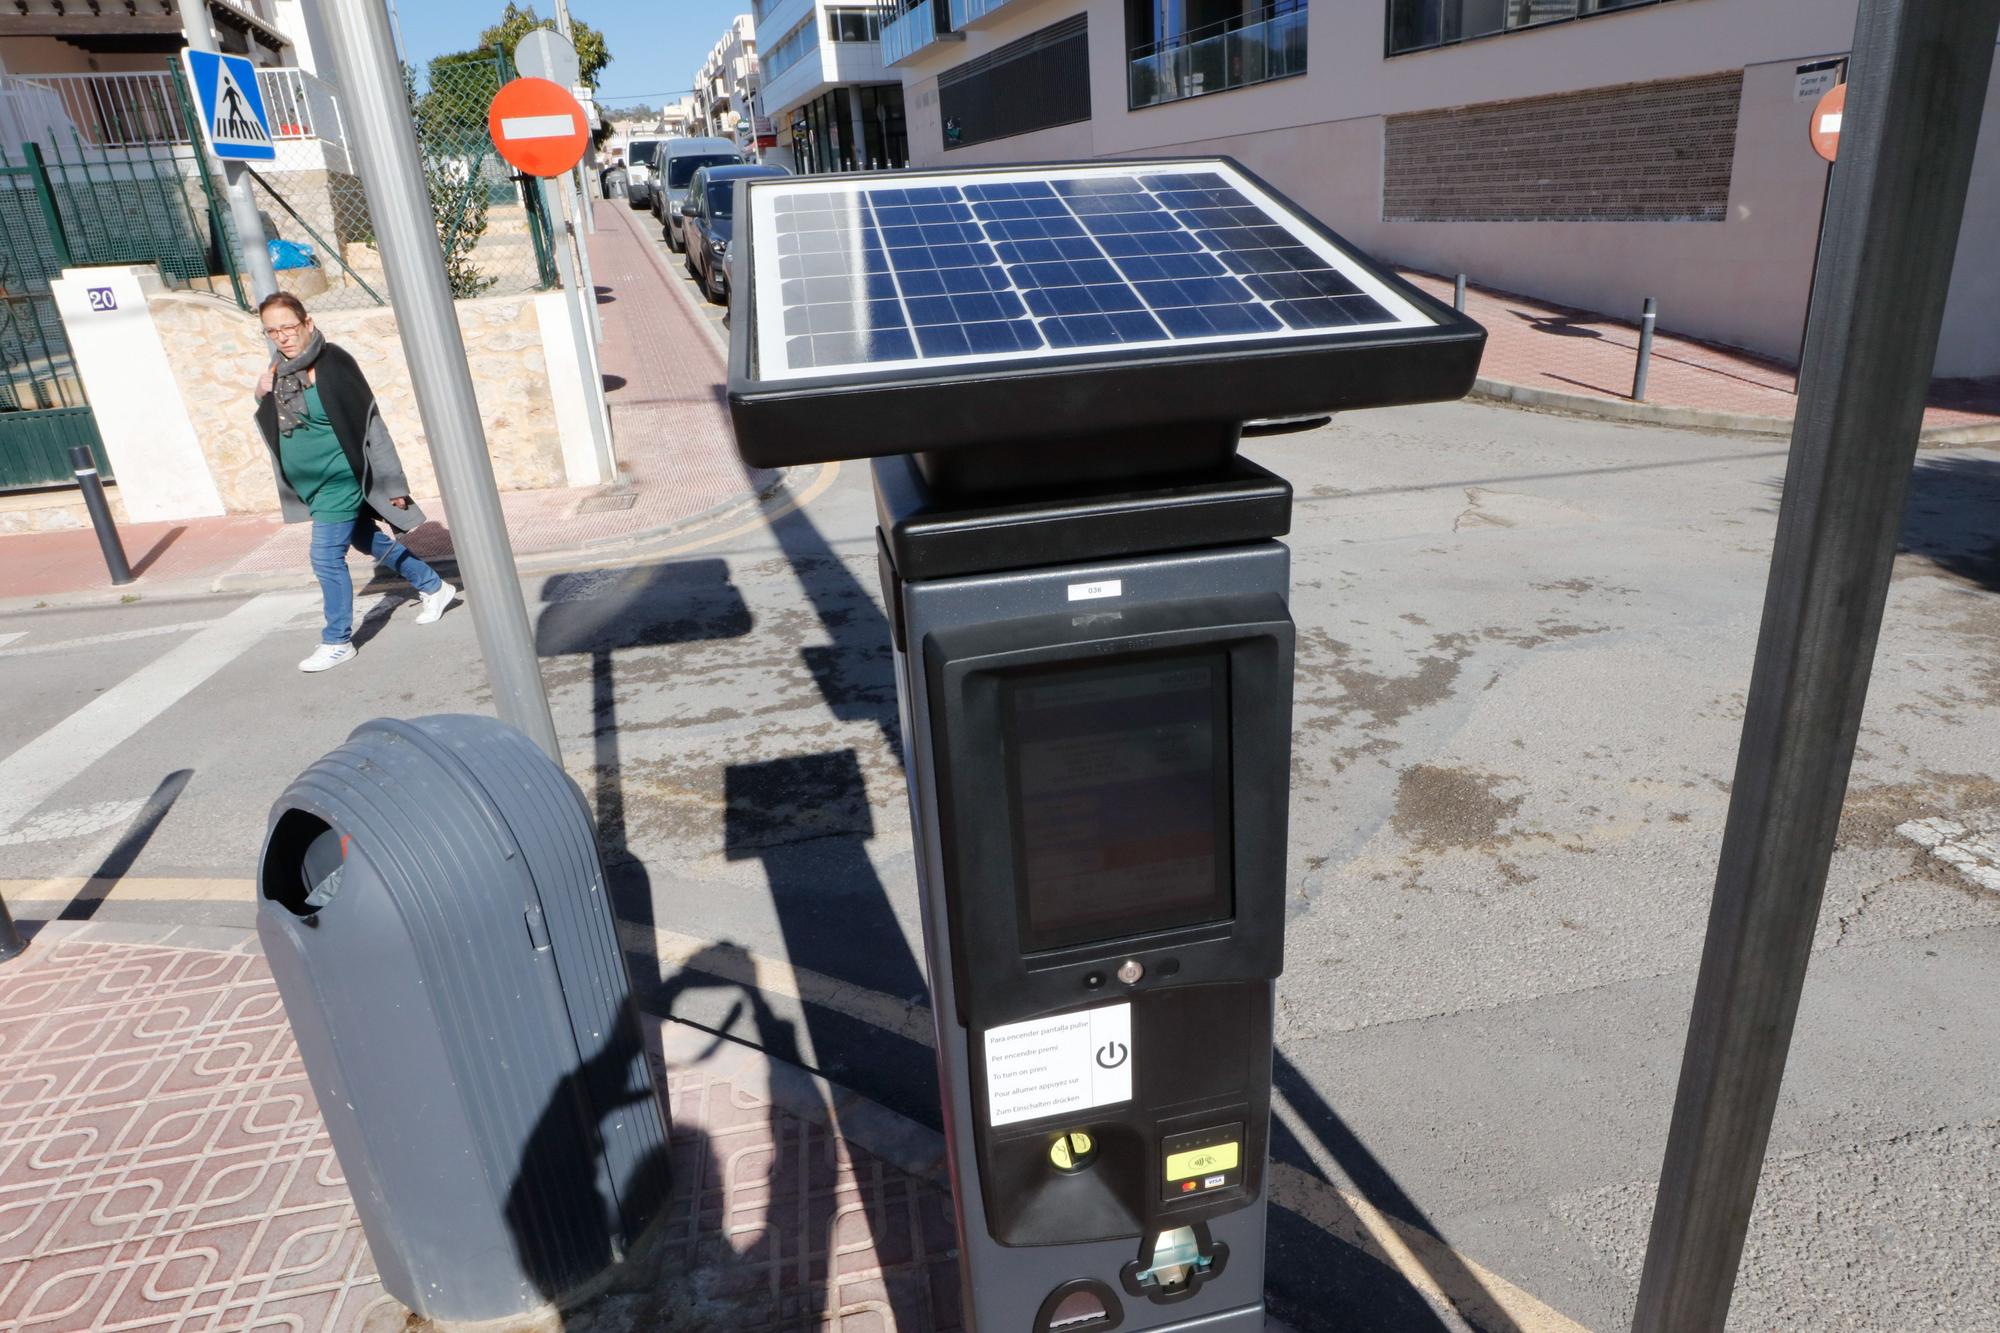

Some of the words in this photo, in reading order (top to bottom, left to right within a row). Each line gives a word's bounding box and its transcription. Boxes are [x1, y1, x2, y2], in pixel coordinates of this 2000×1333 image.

[1799, 87, 1820, 96] Madrid
[89, 290, 115, 308] 20
[1007, 1031, 1039, 1040] encender
[1041, 1025, 1069, 1036] pantalla
[1070, 1022, 1089, 1030] pulse
[1005, 1049, 1036, 1059] encendre
[1003, 1071, 1017, 1079] turn
[1030, 1066, 1047, 1074] press
[1012, 1086, 1037, 1094] allumer
[1039, 1079, 1068, 1089] appuyez
[996, 1108, 1012, 1116] Zum
[1013, 1101, 1051, 1112] Einschalten
[1053, 1095, 1080, 1105] drücken
